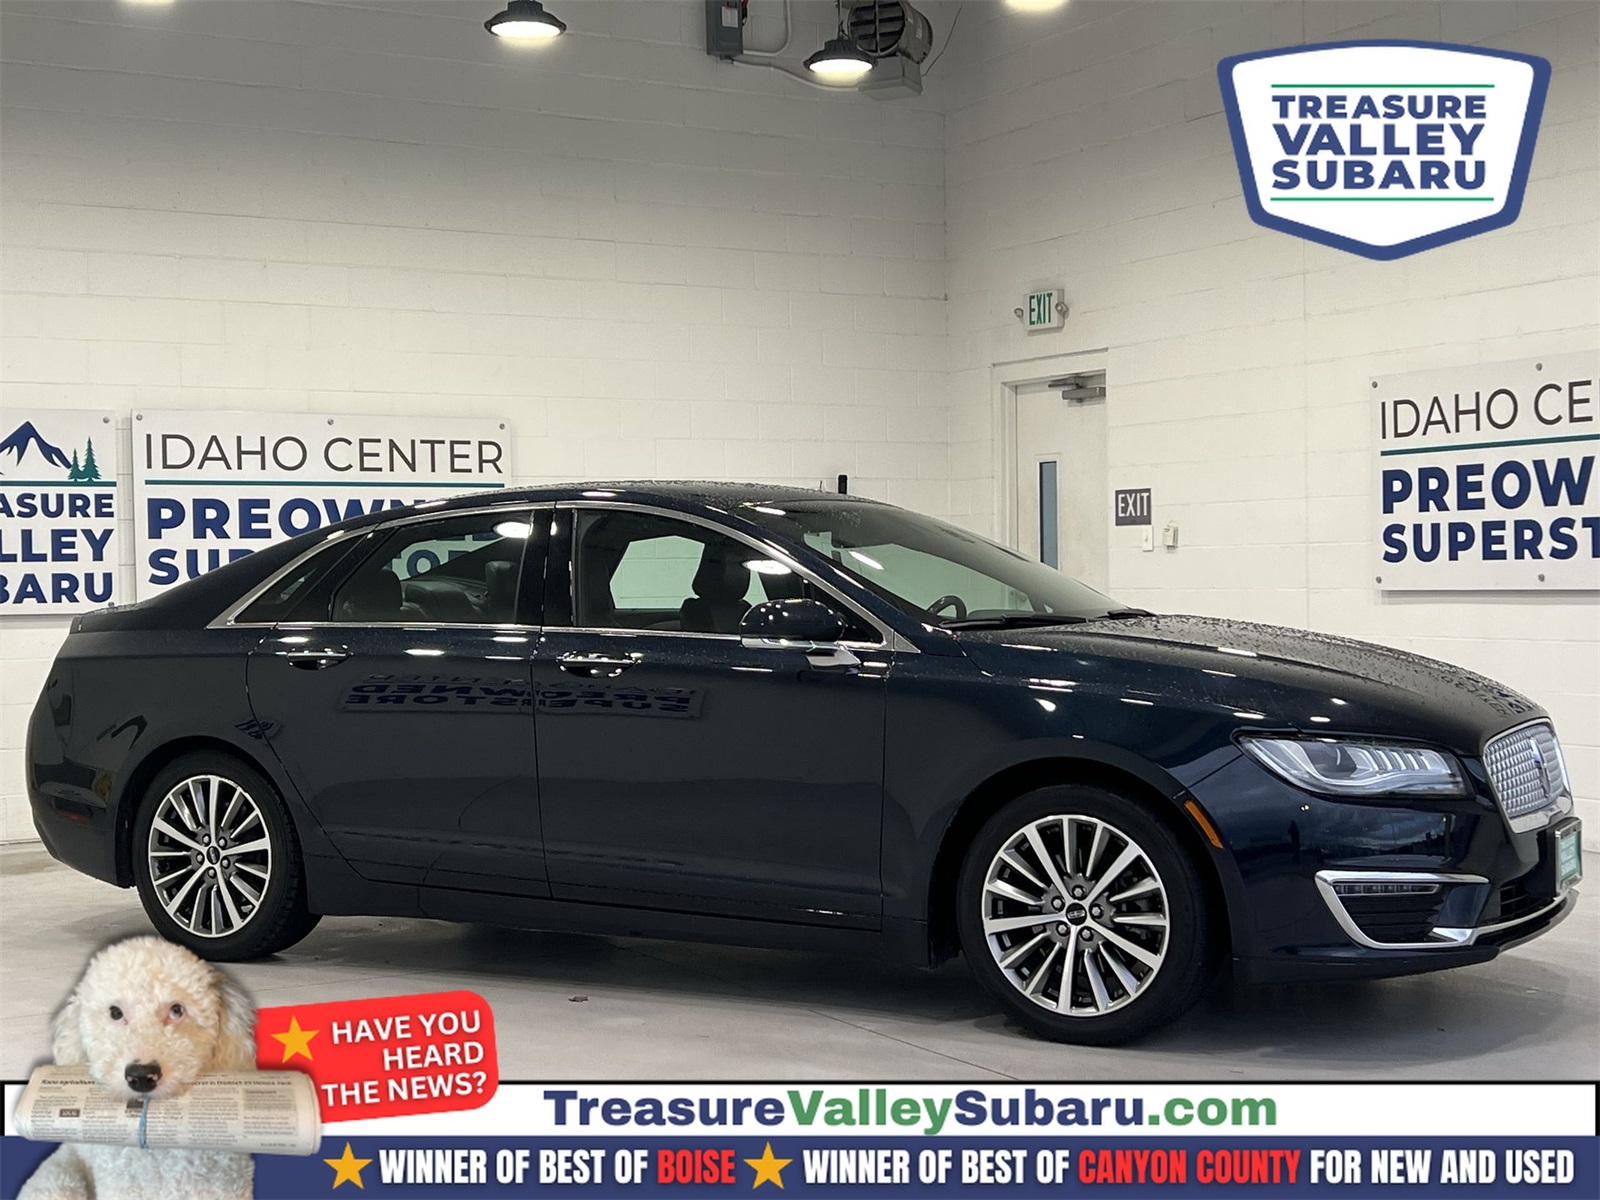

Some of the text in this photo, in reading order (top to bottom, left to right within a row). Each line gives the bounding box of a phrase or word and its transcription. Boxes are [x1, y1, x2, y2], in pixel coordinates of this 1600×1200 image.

[1029, 292, 1053, 326] EXIT
[1381, 380, 1600, 439] IDAHO CE
[146, 433, 504, 474] IDAHO CENTER
[1118, 492, 1150, 518] EXIT
[1382, 456, 1596, 514] PREOW
[147, 498, 426, 540] PREOW
